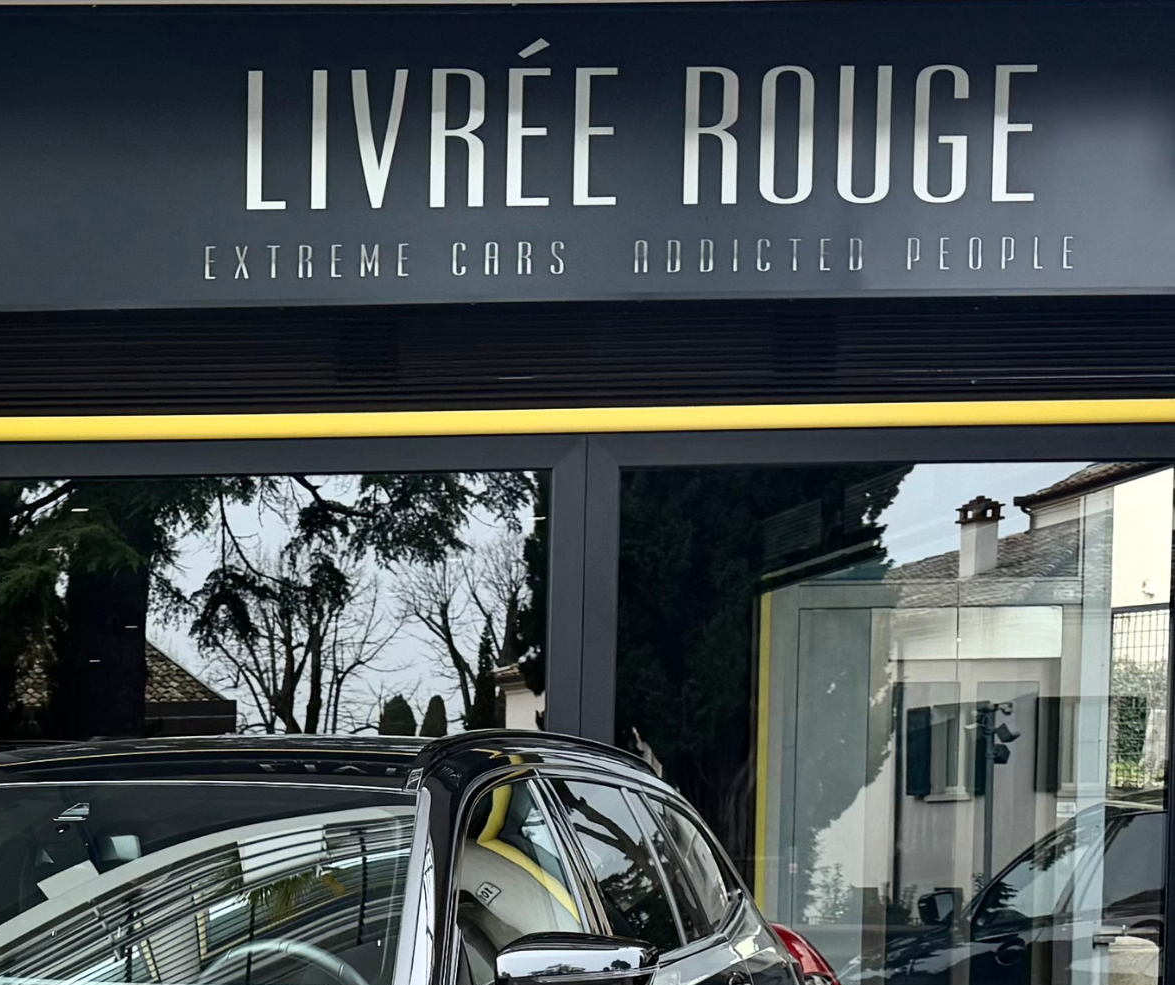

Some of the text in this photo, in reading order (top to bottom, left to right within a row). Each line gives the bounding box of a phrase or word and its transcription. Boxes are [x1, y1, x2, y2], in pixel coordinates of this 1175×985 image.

[245, 37, 1039, 211] LIVRÉE ROUGE
[203, 235, 1075, 281] EXTREME CARS ADDICTED PEOPLE
